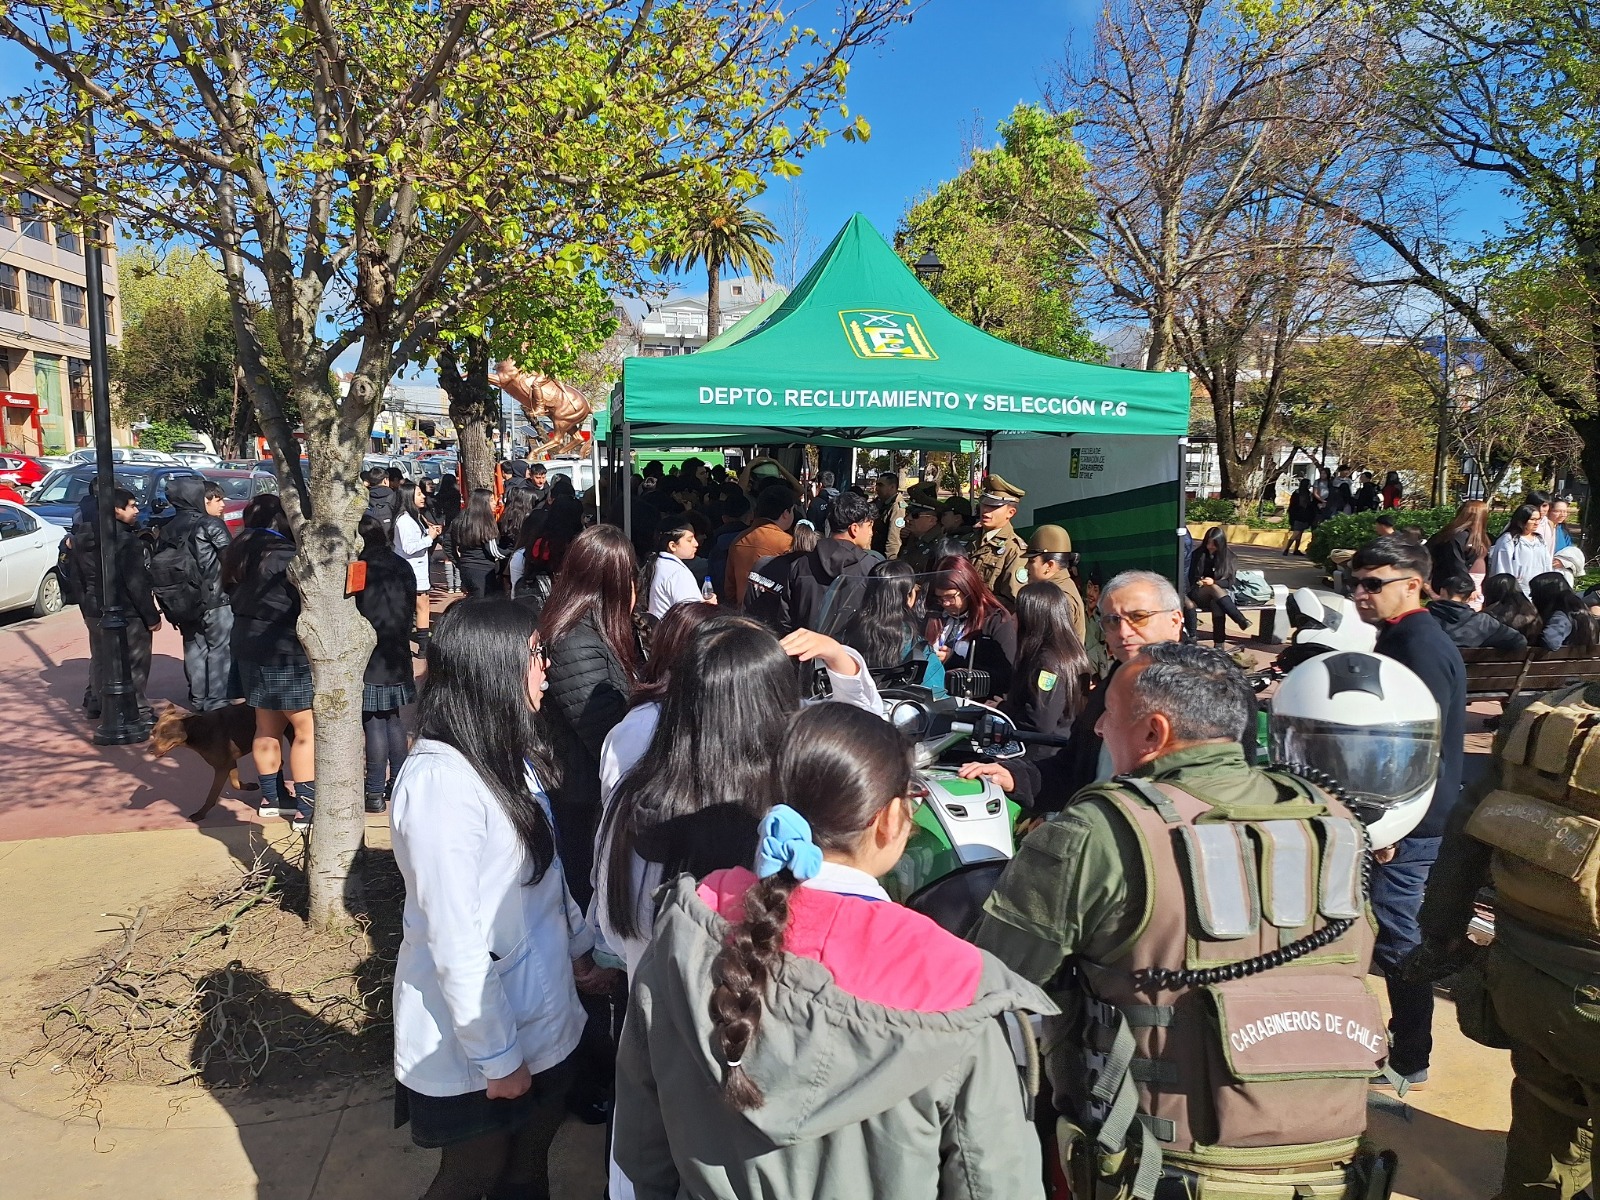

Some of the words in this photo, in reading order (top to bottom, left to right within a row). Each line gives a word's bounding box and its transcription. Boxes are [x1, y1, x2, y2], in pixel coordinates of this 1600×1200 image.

[699, 386, 778, 406] DEPTO.
[785, 389, 960, 410] RECLUTAMIENTO
[964, 393, 978, 410] Y
[983, 394, 1095, 416] SELECCIÓN
[1100, 400, 1128, 417] P.6
[1231, 1011, 1321, 1052] CARABINEROS
[1325, 1013, 1343, 1035] DE
[1346, 1020, 1383, 1054] CHILE
